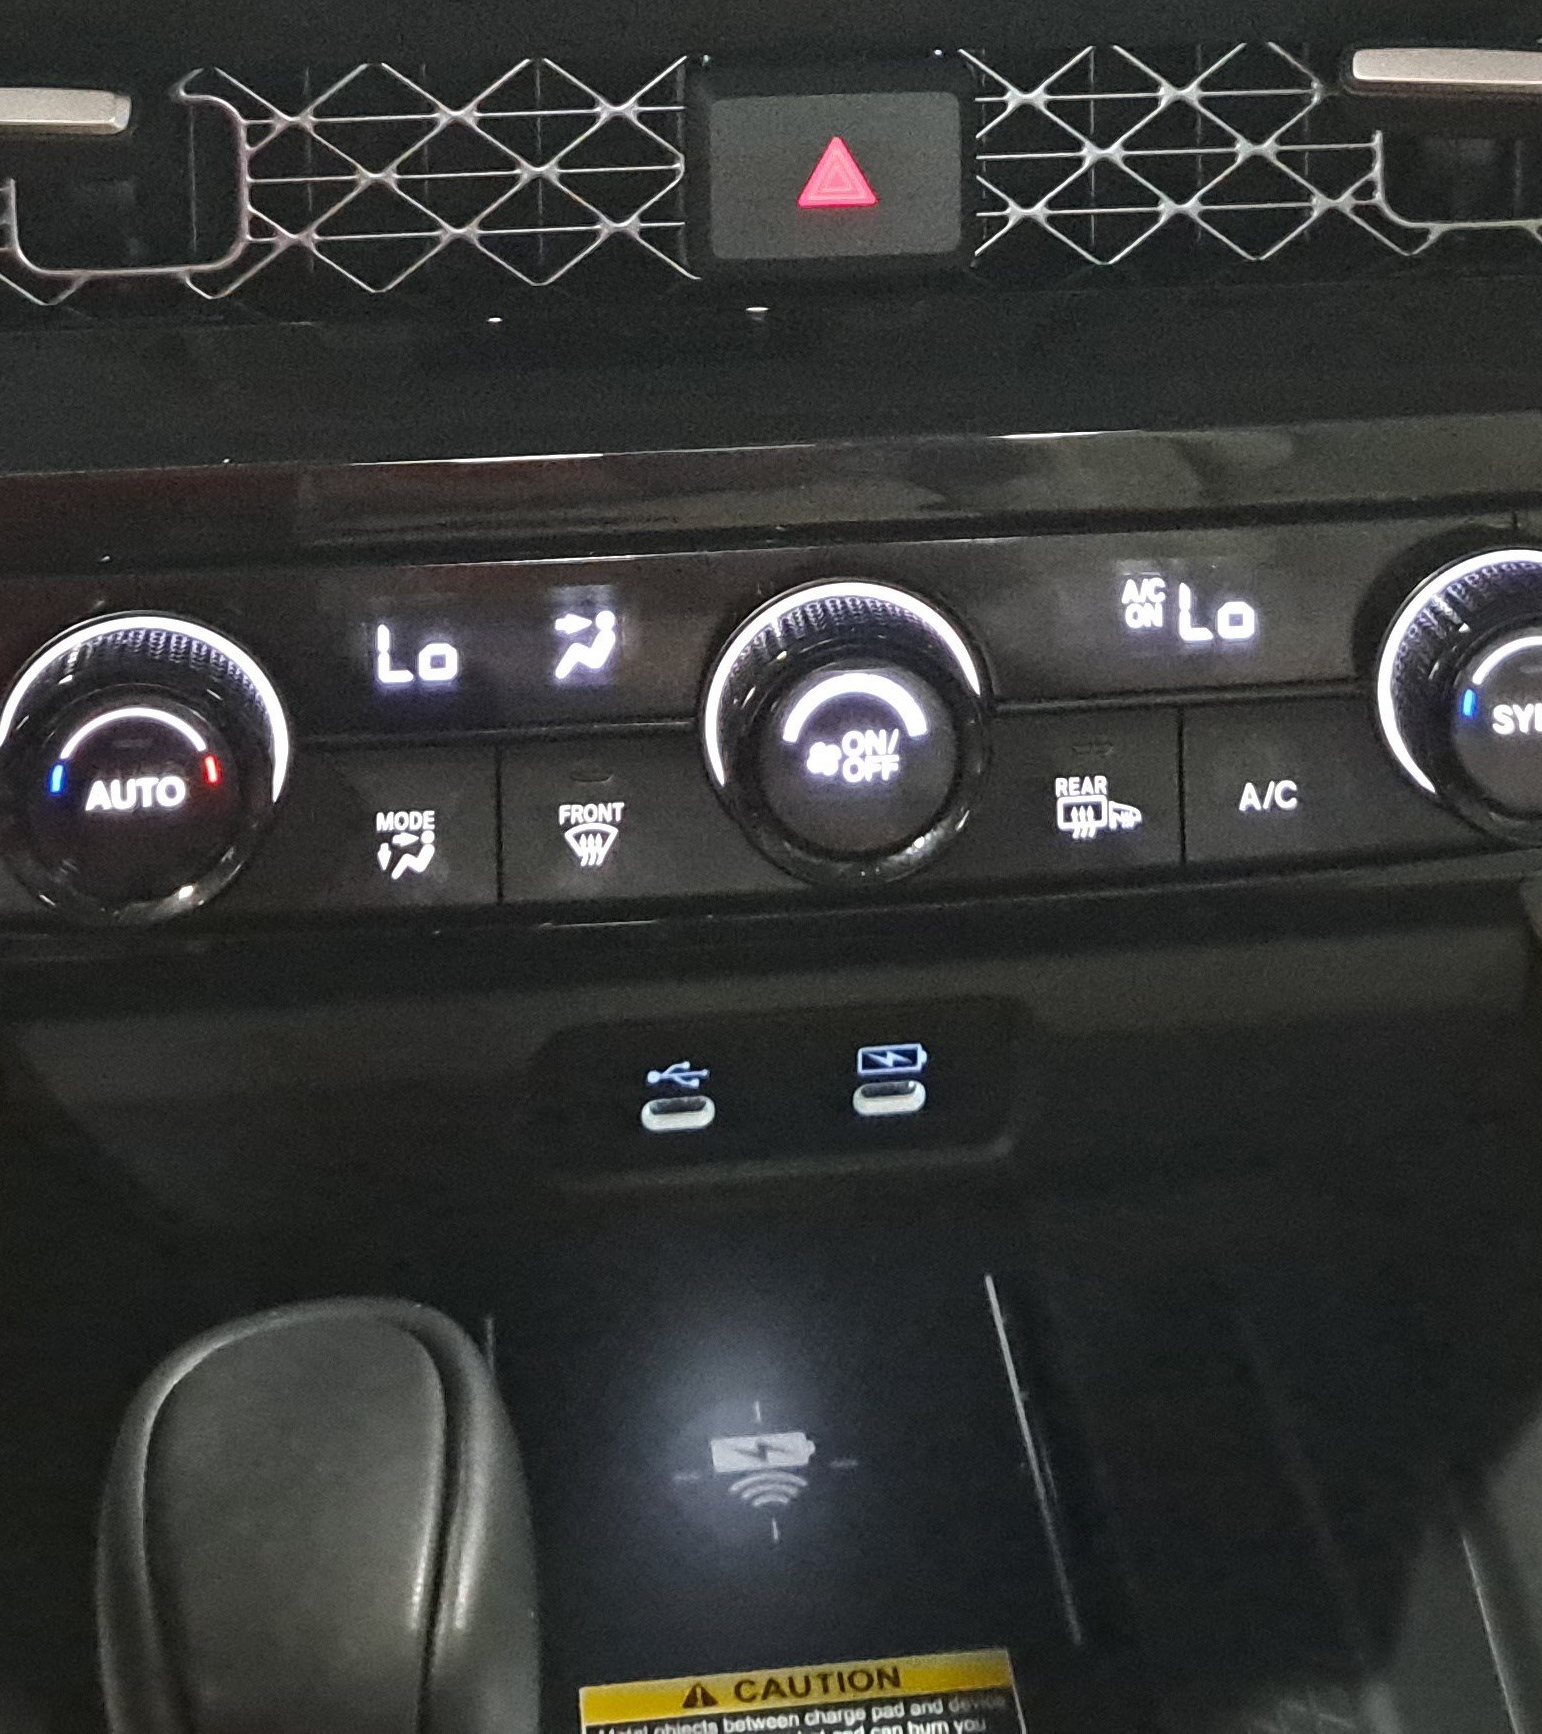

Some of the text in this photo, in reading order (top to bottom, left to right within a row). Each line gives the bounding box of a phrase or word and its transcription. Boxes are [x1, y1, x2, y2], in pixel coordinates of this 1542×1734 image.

[1121, 577, 1166, 604] A/C
[1124, 603, 1163, 628] ON
[843, 755, 899, 782] OFF
[85, 776, 186, 811] AUTO
[1055, 775, 1107, 797] REAR
[1238, 780, 1298, 811] A/C
[376, 810, 435, 832] MODE
[559, 802, 625, 825] FRONT
[733, 1666, 902, 1703] CAUTION
[723, 1713, 800, 1733] between
[804, 1708, 866, 1727] charge
[871, 1699, 905, 1723] pad
[910, 1697, 944, 1716] and
